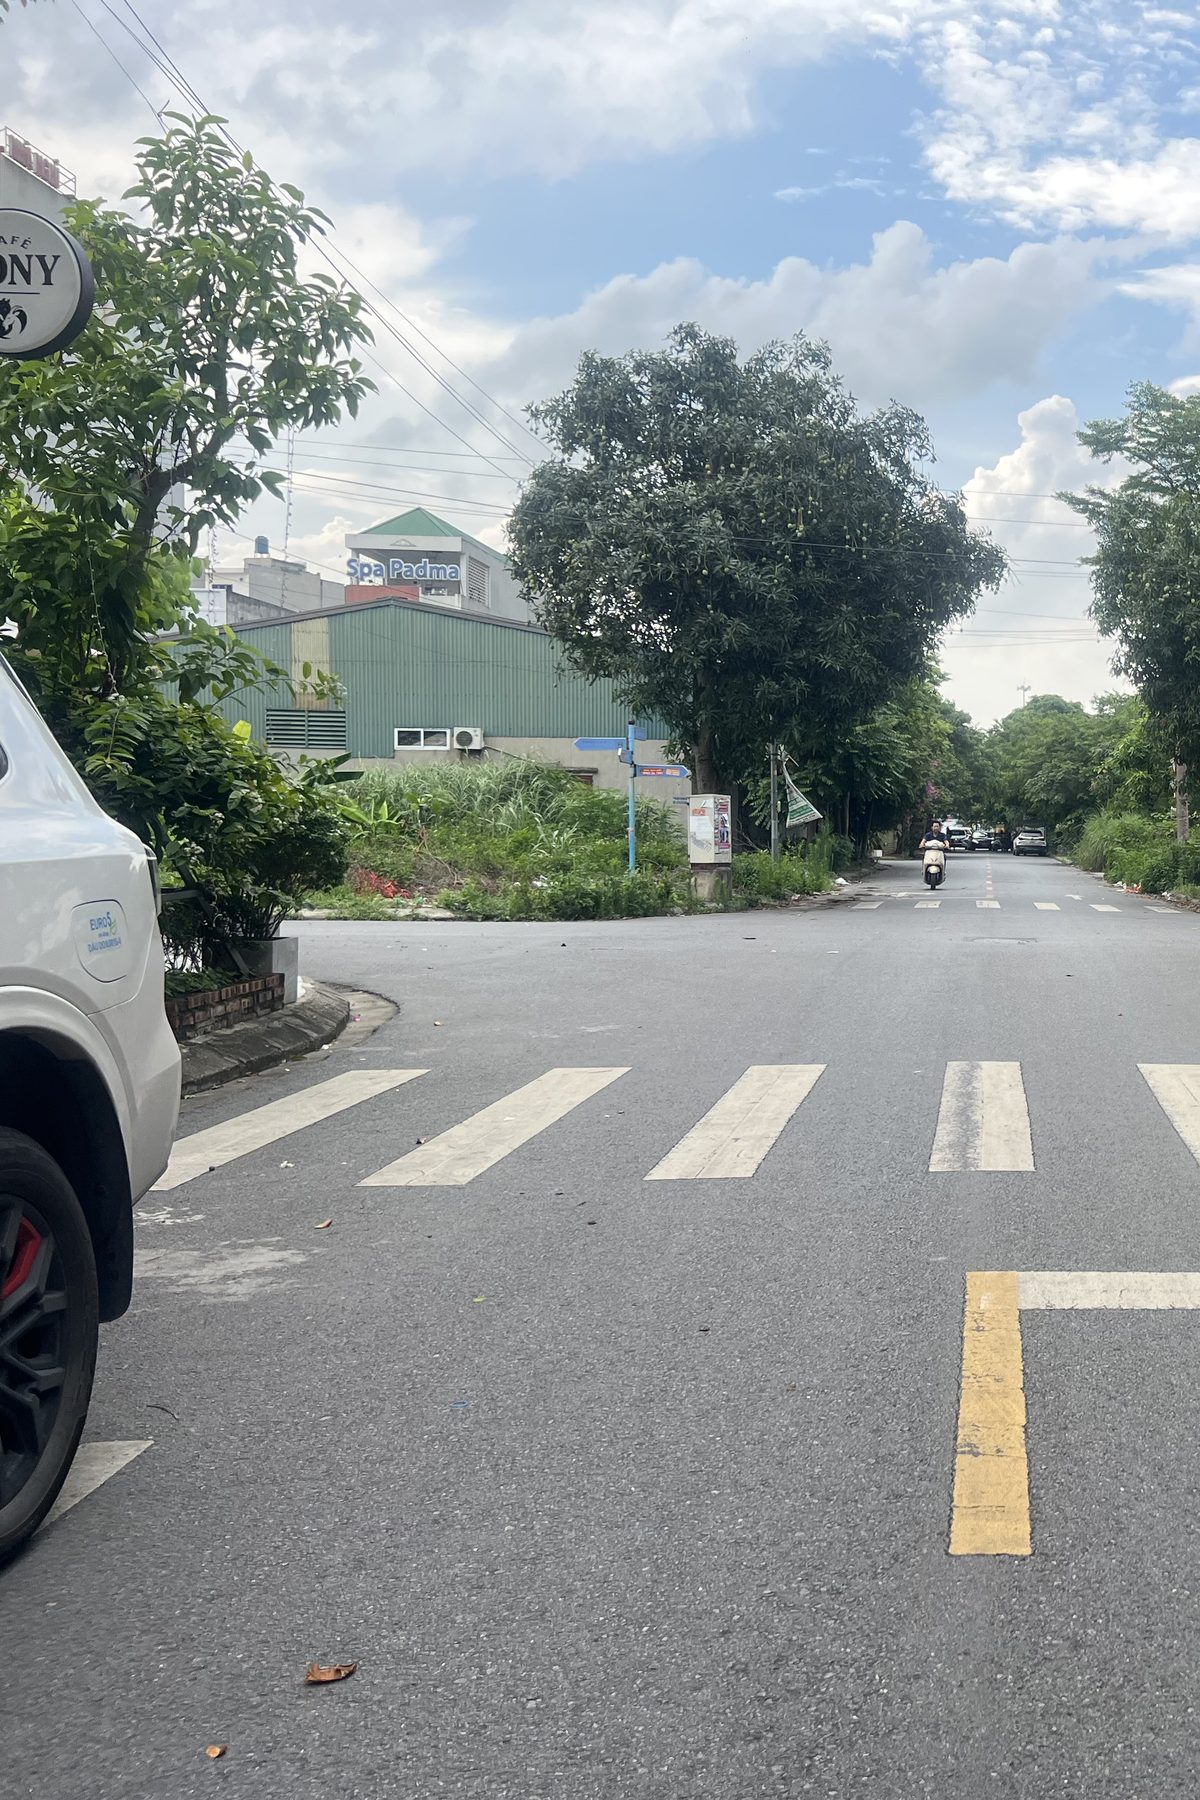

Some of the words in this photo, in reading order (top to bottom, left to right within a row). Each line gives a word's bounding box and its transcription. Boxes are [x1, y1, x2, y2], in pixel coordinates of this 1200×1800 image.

[0, 253, 61, 286] NY
[347, 558, 384, 581] Spa
[389, 558, 460, 580] Padma
